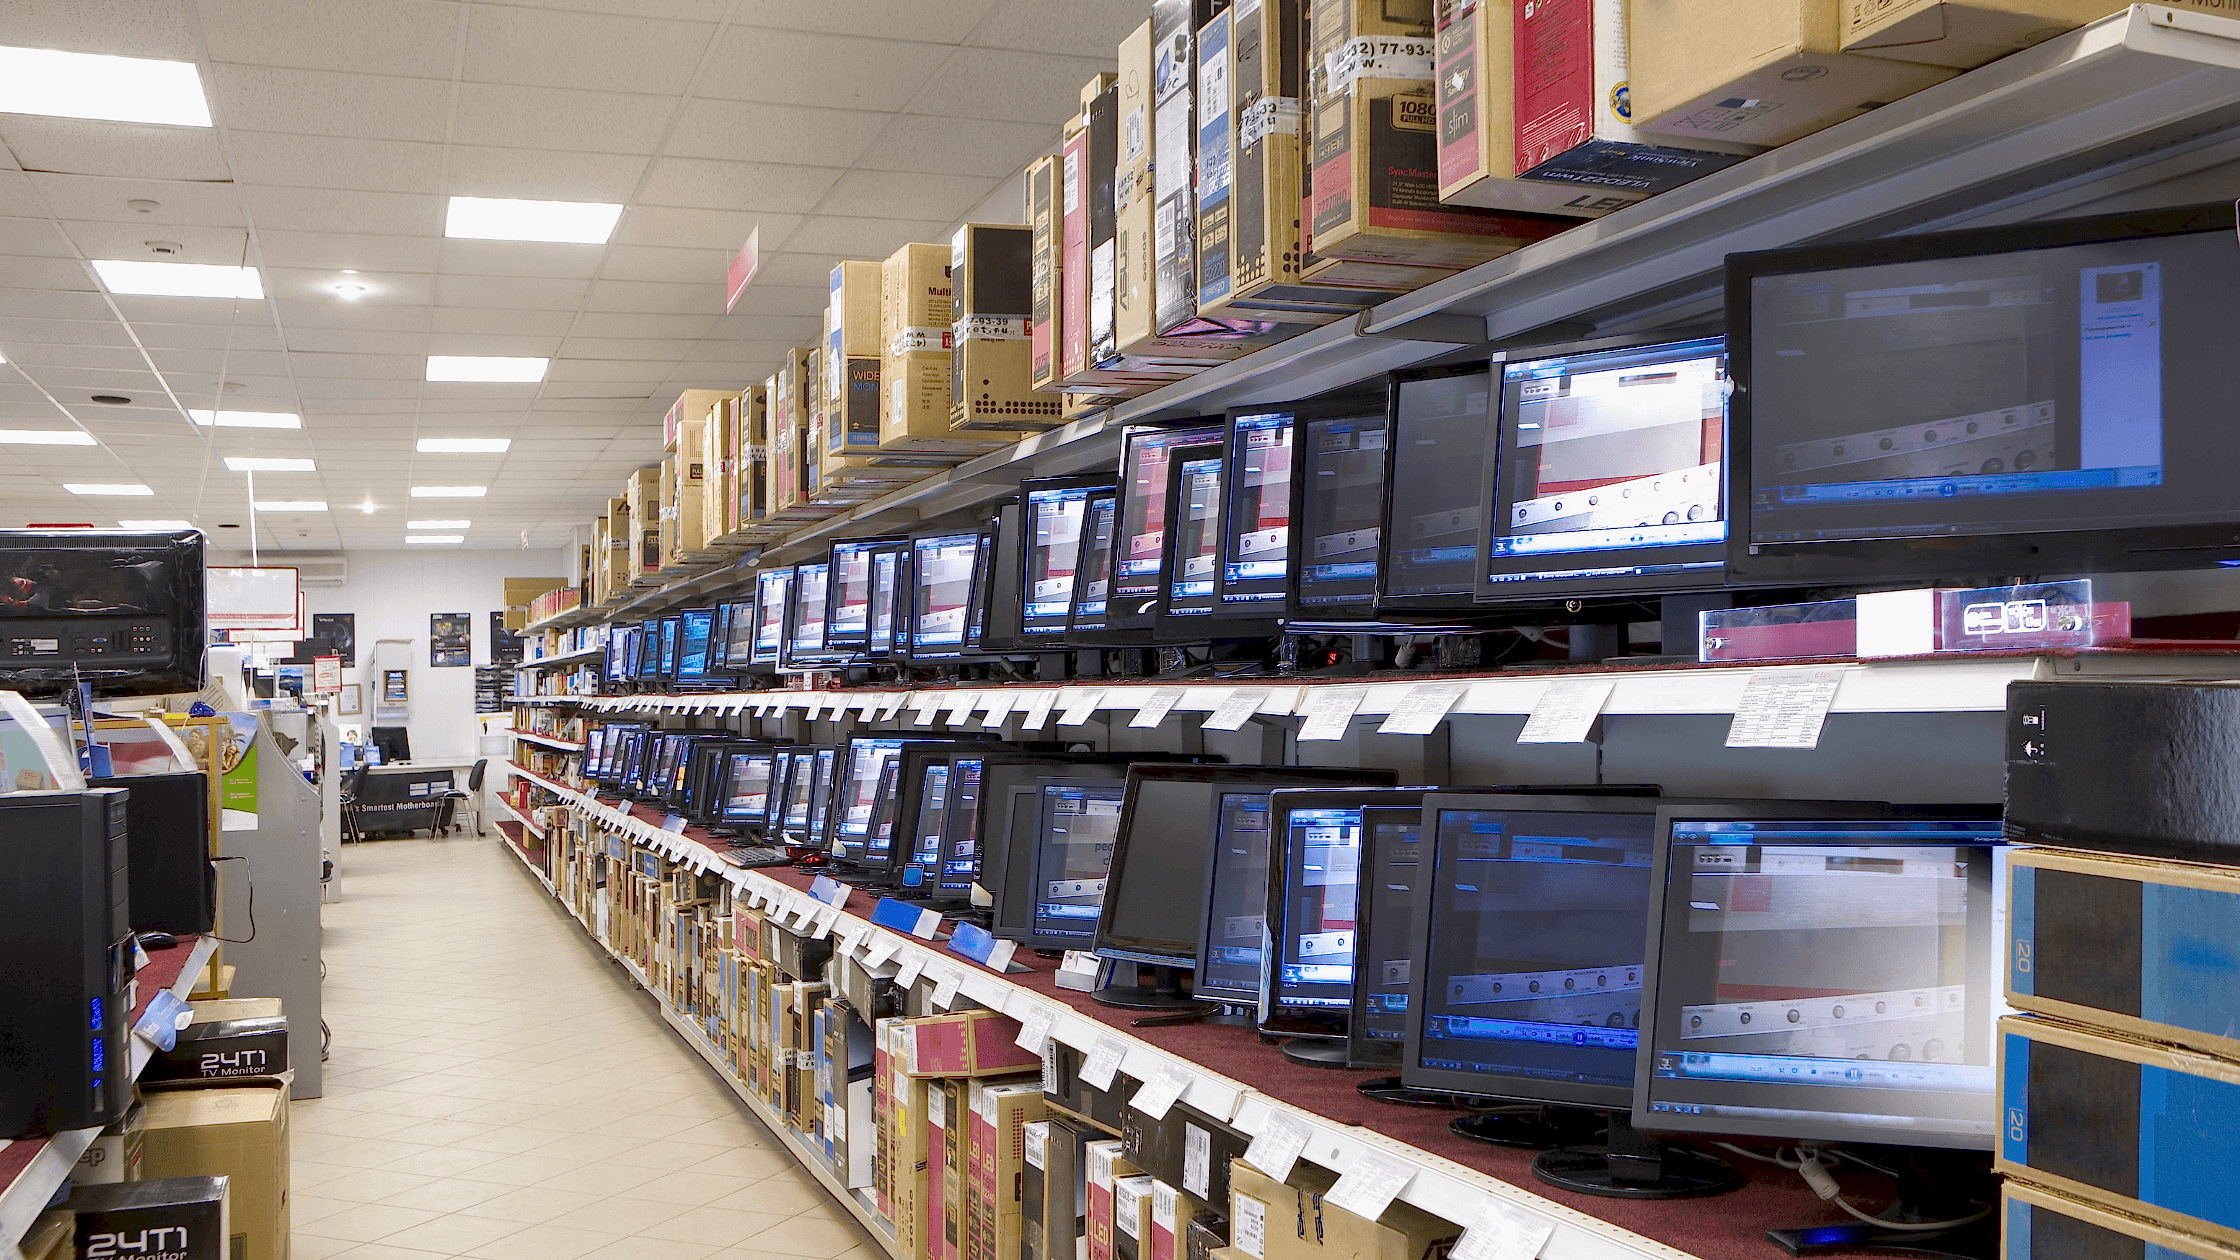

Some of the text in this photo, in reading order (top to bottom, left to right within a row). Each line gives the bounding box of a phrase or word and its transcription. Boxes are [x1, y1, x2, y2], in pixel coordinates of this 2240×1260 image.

[1380, 43, 1434, 57] 77-93-
[1448, 107, 1469, 138] slim
[1120, 230, 1128, 311] ASUS
[852, 371, 880, 381] WIDE
[361, 802, 395, 813] Smartest
[2018, 944, 2031, 974] 20
[200, 1049, 266, 1070] 24T1
[202, 1066, 266, 1077] TV Monitor
[2011, 1111, 2023, 1142] 20
[969, 1137, 980, 1161] LED
[982, 1150, 994, 1173] LED
[86, 1226, 188, 1259] 24T1
[1093, 1218, 1109, 1246] LED
